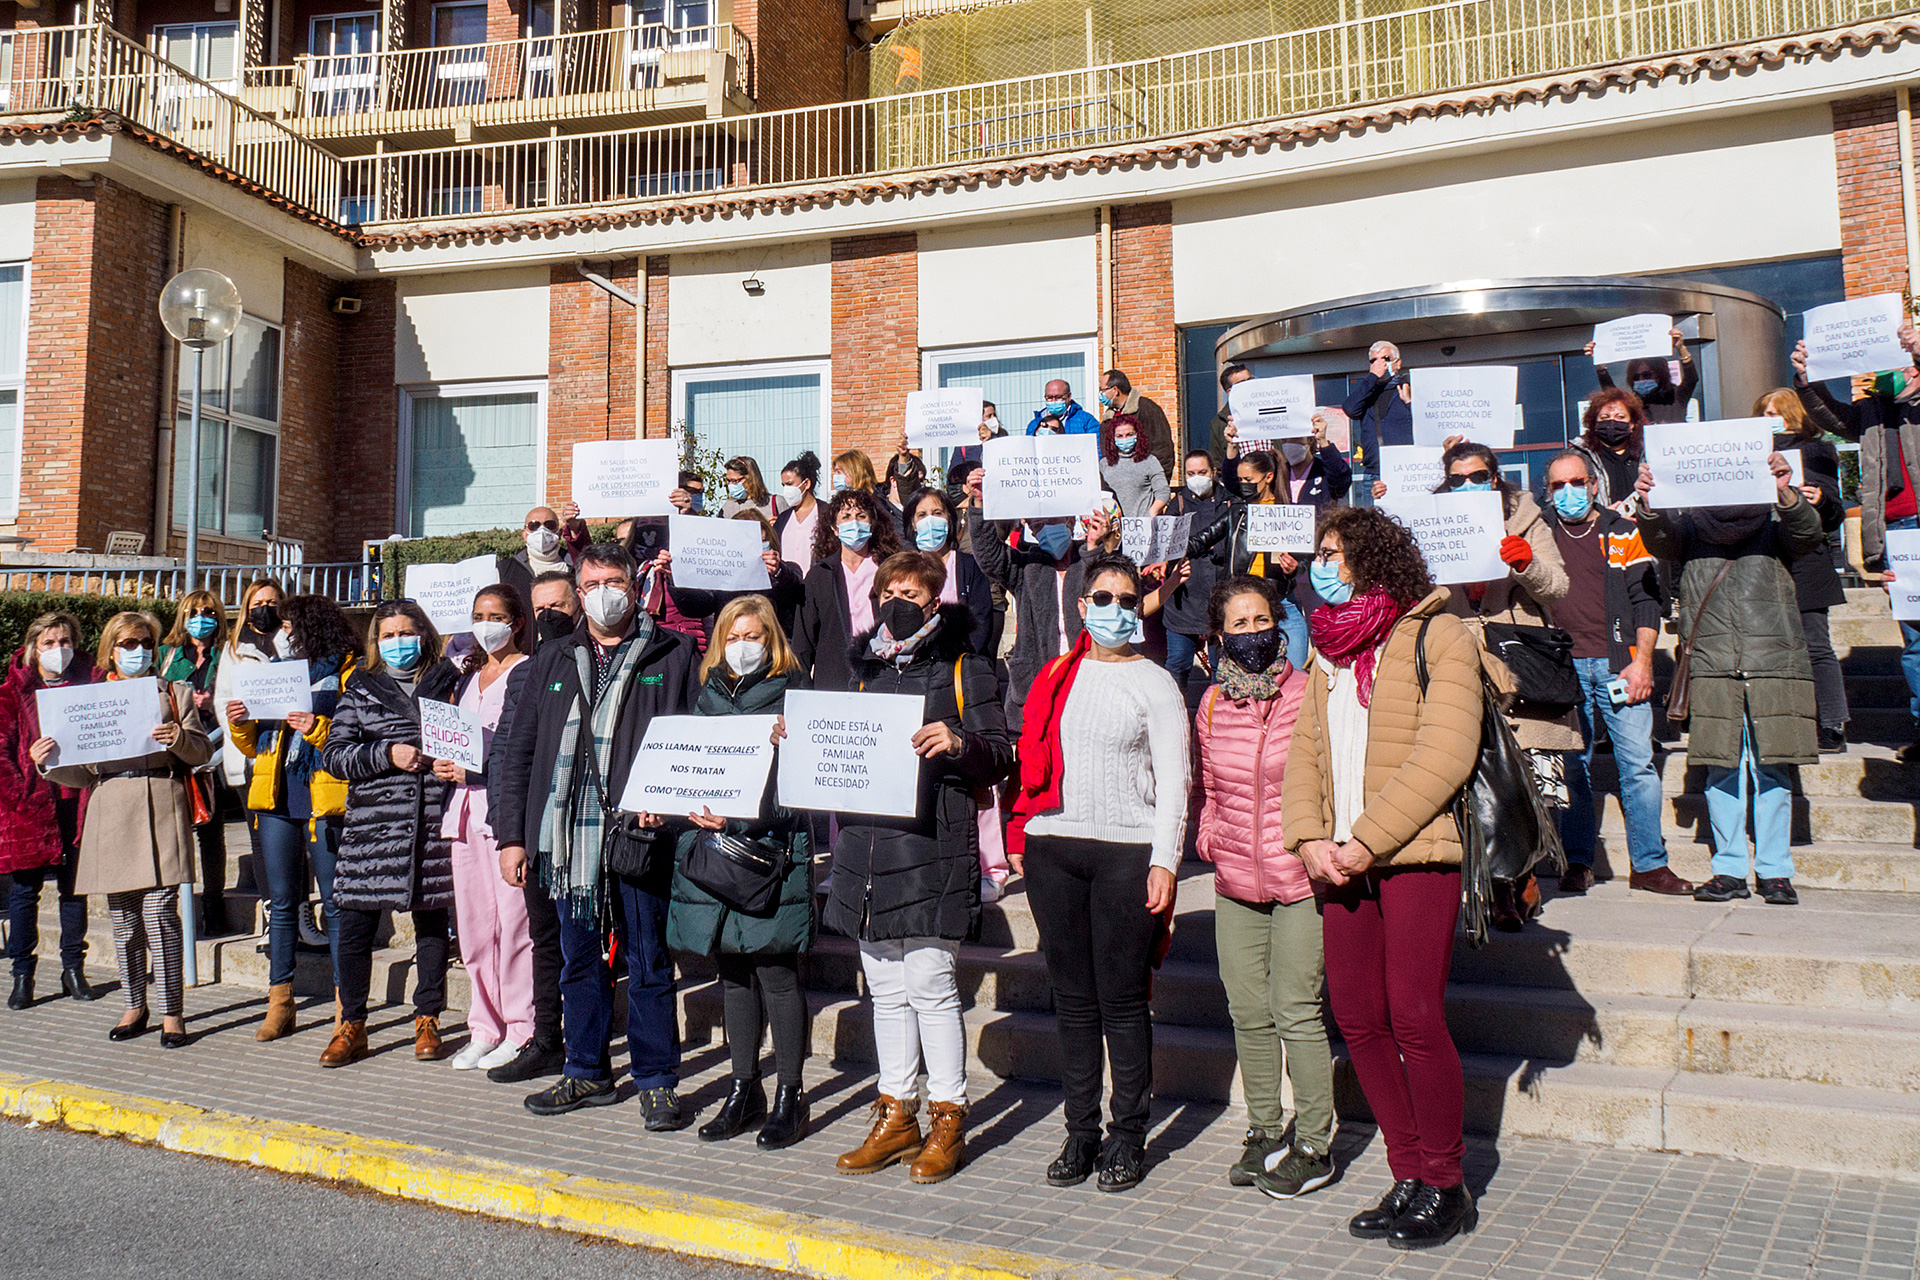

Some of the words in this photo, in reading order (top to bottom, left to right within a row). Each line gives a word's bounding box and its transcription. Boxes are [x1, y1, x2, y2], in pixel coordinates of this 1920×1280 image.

[1826, 321, 1849, 331] TRATO
[1851, 317, 1868, 327] QUE
[1870, 314, 1887, 323] NOS
[1825, 333, 1841, 342] DAN
[1817, 344, 1840, 353] TRATO
[1842, 341, 1859, 349] QUE
[1861, 335, 1889, 345] HEMOS
[1427, 400, 1470, 408] ASISTENCIAL
[1441, 410, 1479, 418] DOTACIÓN
[1663, 446, 1676, 456] LA
[1679, 441, 1740, 455] VOCACIÓN
[1745, 441, 1763, 451] NO
[1014, 457, 1039, 465] TRATO
[1042, 457, 1060, 465] QUE
[1677, 458, 1732, 470] JUSTIFICA
[1736, 456, 1750, 466] LA
[1012, 468, 1030, 476] DAN
[1675, 469, 1754, 484] EXPLOTACIÓN
[1000, 480, 1027, 488] TRATO
[1030, 479, 1048, 487] QUE
[1051, 477, 1082, 486] HEMOS
[1252, 506, 1312, 518] PLANTILLAS
[1457, 515, 1469, 523] DE
[1123, 519, 1143, 531] POR
[1250, 522, 1262, 531] AL
[1264, 521, 1303, 531] MINIMO
[1431, 527, 1475, 538] AHORRAR
[697, 538, 726, 546] CALIDAD
[1449, 540, 1466, 549] DEL
[682, 547, 724, 556] ASISTENCIAL
[727, 550, 743, 558] CON
[696, 568, 733, 576] PERSONAL
[463, 577, 471, 585] DE
[445, 587, 474, 597] AHORRAR
[249, 677, 288, 686] VOCACIÓN
[249, 688, 283, 696] JUSTIFICA
[250, 696, 297, 705] EXPLOTACIÓN
[64, 702, 97, 714] ¿DÓNDE
[99, 699, 118, 709] ESTÁ
[69, 709, 126, 722] CONCILIACIÓN
[81, 720, 118, 730] FAMILIAR
[807, 718, 846, 730] ¿DÓNDE
[849, 720, 869, 732] ESTÁ
[872, 723, 883, 732] LA
[78, 731, 95, 741] CON
[98, 730, 123, 739] TANTA
[812, 734, 876, 746] CONCILIACIÓN
[77, 739, 126, 750] NECESIDAD?
[643, 743, 663, 751] ¡NOS
[665, 744, 701, 752] LLAMAN
[823, 749, 864, 760] FAMILIAR
[671, 765, 689, 773] NOS
[692, 766, 725, 775] TRATAN
[818, 762, 837, 772] CON
[841, 764, 868, 774] TANTA
[815, 776, 869, 789] NECESIDAD?
